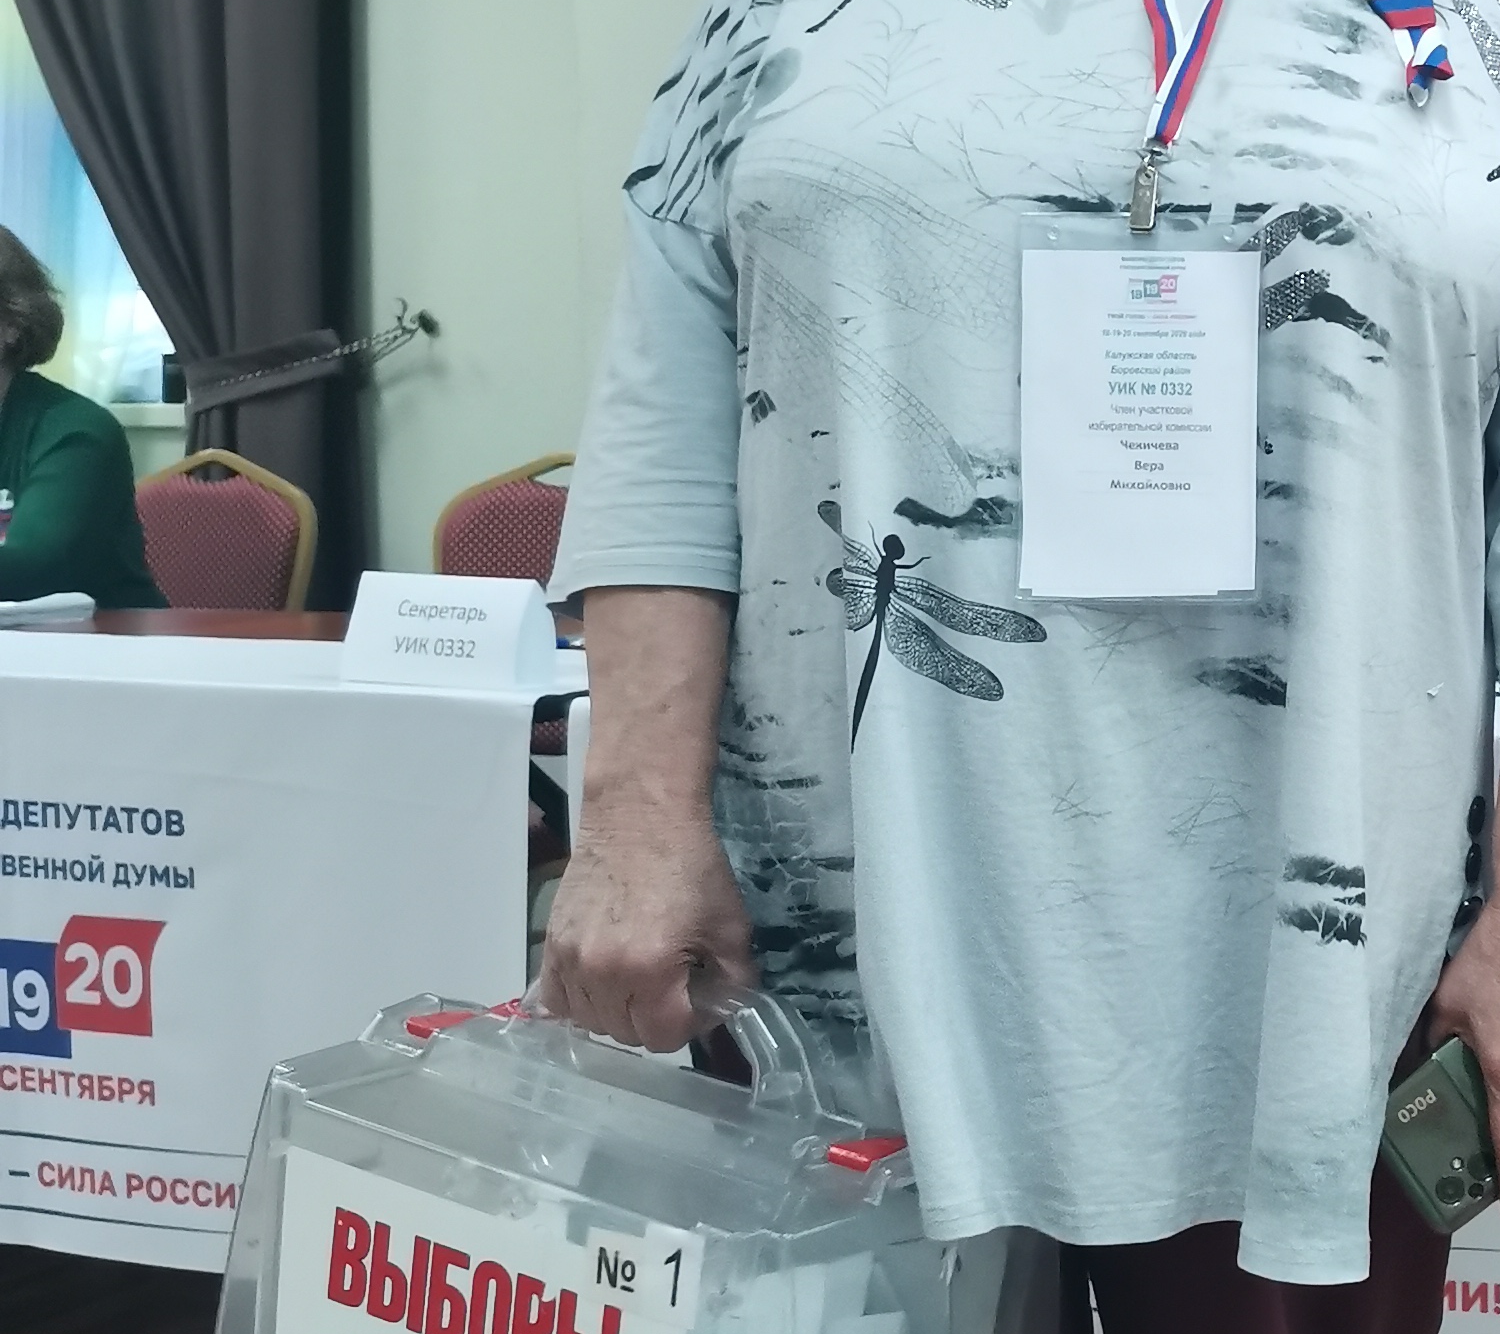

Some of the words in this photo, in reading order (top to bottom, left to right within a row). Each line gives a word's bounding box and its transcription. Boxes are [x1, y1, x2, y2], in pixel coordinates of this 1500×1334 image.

[1160, 278, 1177, 290] 20
[1105, 350, 1154, 361] Калужская
[1156, 350, 1197, 360] область
[1108, 381, 1137, 396] УИК
[1141, 382, 1156, 395] №
[1160, 382, 1193, 396] 0332
[1110, 404, 1135, 415] Член
[1138, 404, 1193, 417] участковой
[1088, 420, 1163, 432] избирательной
[1134, 460, 1165, 473] Вера
[397, 598, 488, 624] Секретарь
[394, 635, 430, 656] УИК
[433, 638, 477, 659] 0332
[0, 799, 186, 837] ДЕПУТАТОВ
[112, 862, 196, 890] ДУМЫ
[63, 940, 144, 1009] 20
[0, 1064, 156, 1108] СЕНТЯБРЯ
[1397, 1088, 1437, 1123] POCO
[37, 1161, 118, 1198] СИЛА
[125, 1172, 243, 1210] РОССИ
[595, 1245, 637, 1294] №
[663, 1247, 684, 1308] 1
